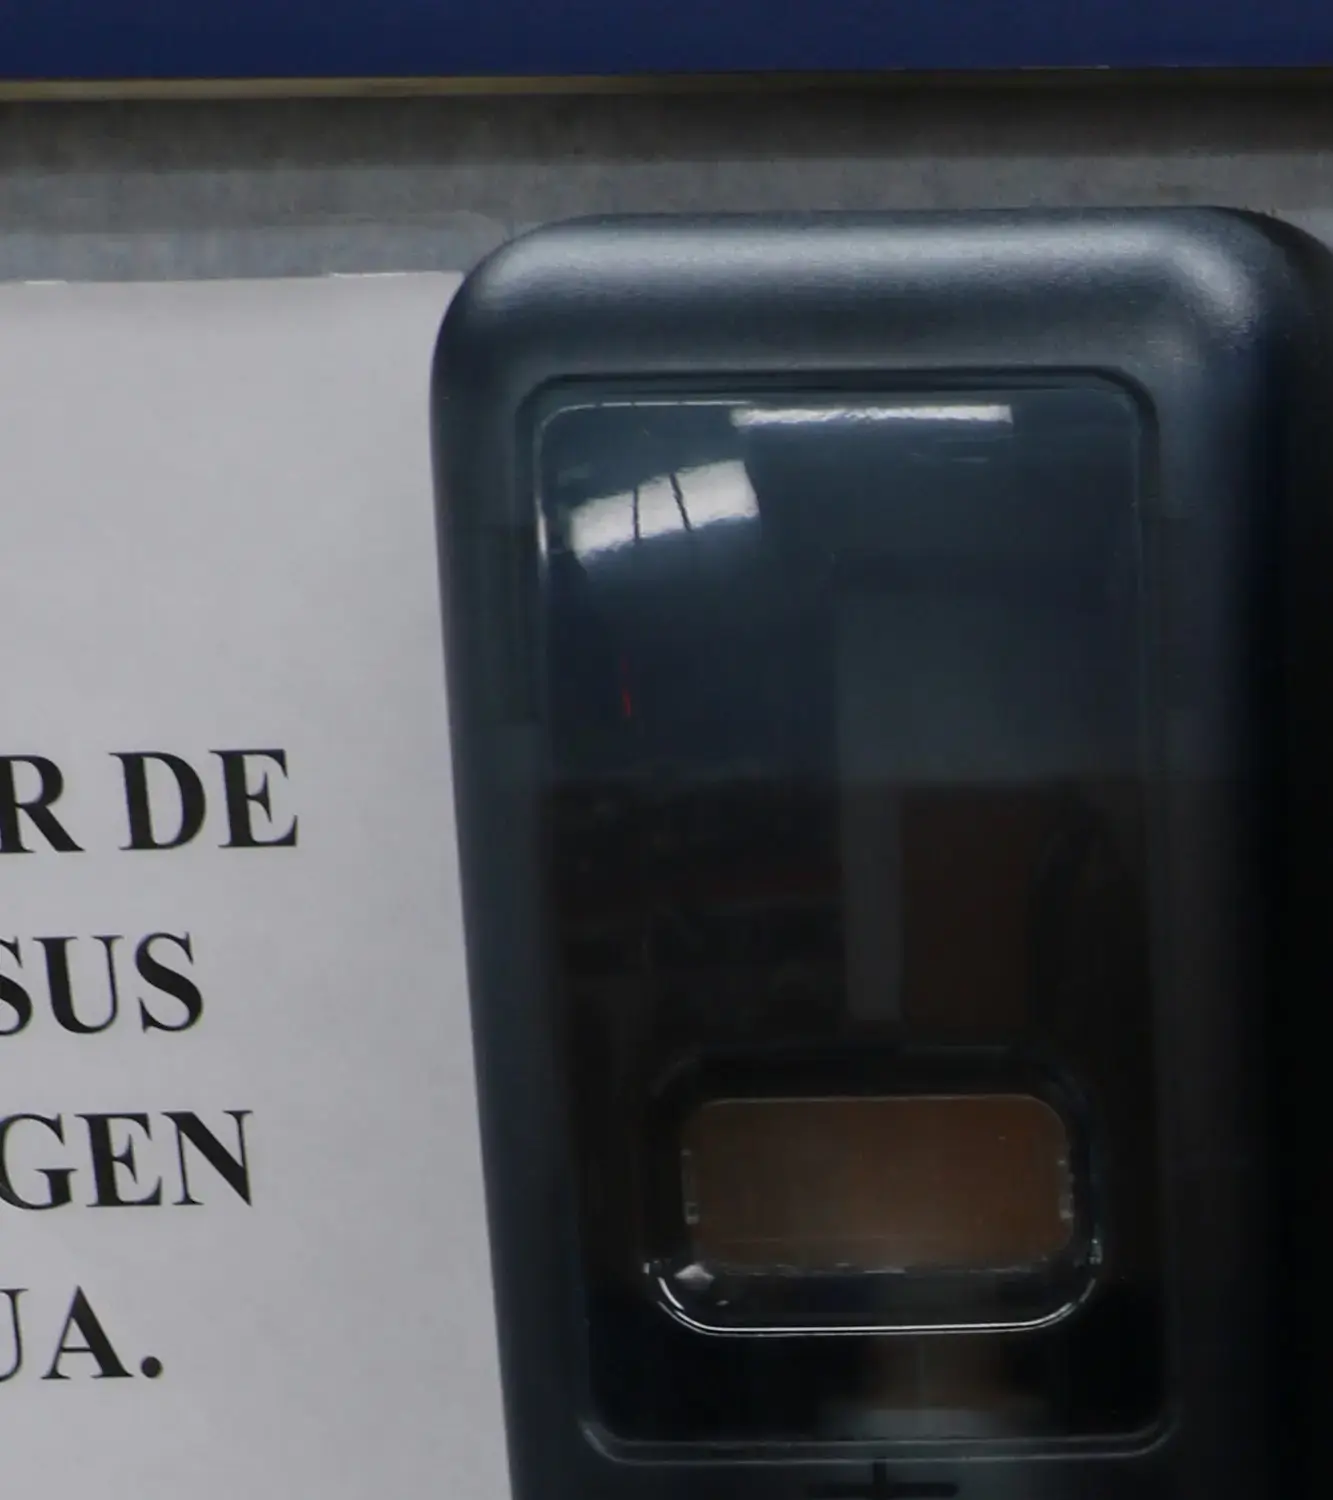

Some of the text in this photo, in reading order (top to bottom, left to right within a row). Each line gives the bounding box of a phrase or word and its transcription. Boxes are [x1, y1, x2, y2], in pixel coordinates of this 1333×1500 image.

[108, 748, 298, 851] DE
[0, 1109, 253, 1211] GEN
[0, 1285, 164, 1384] A.
